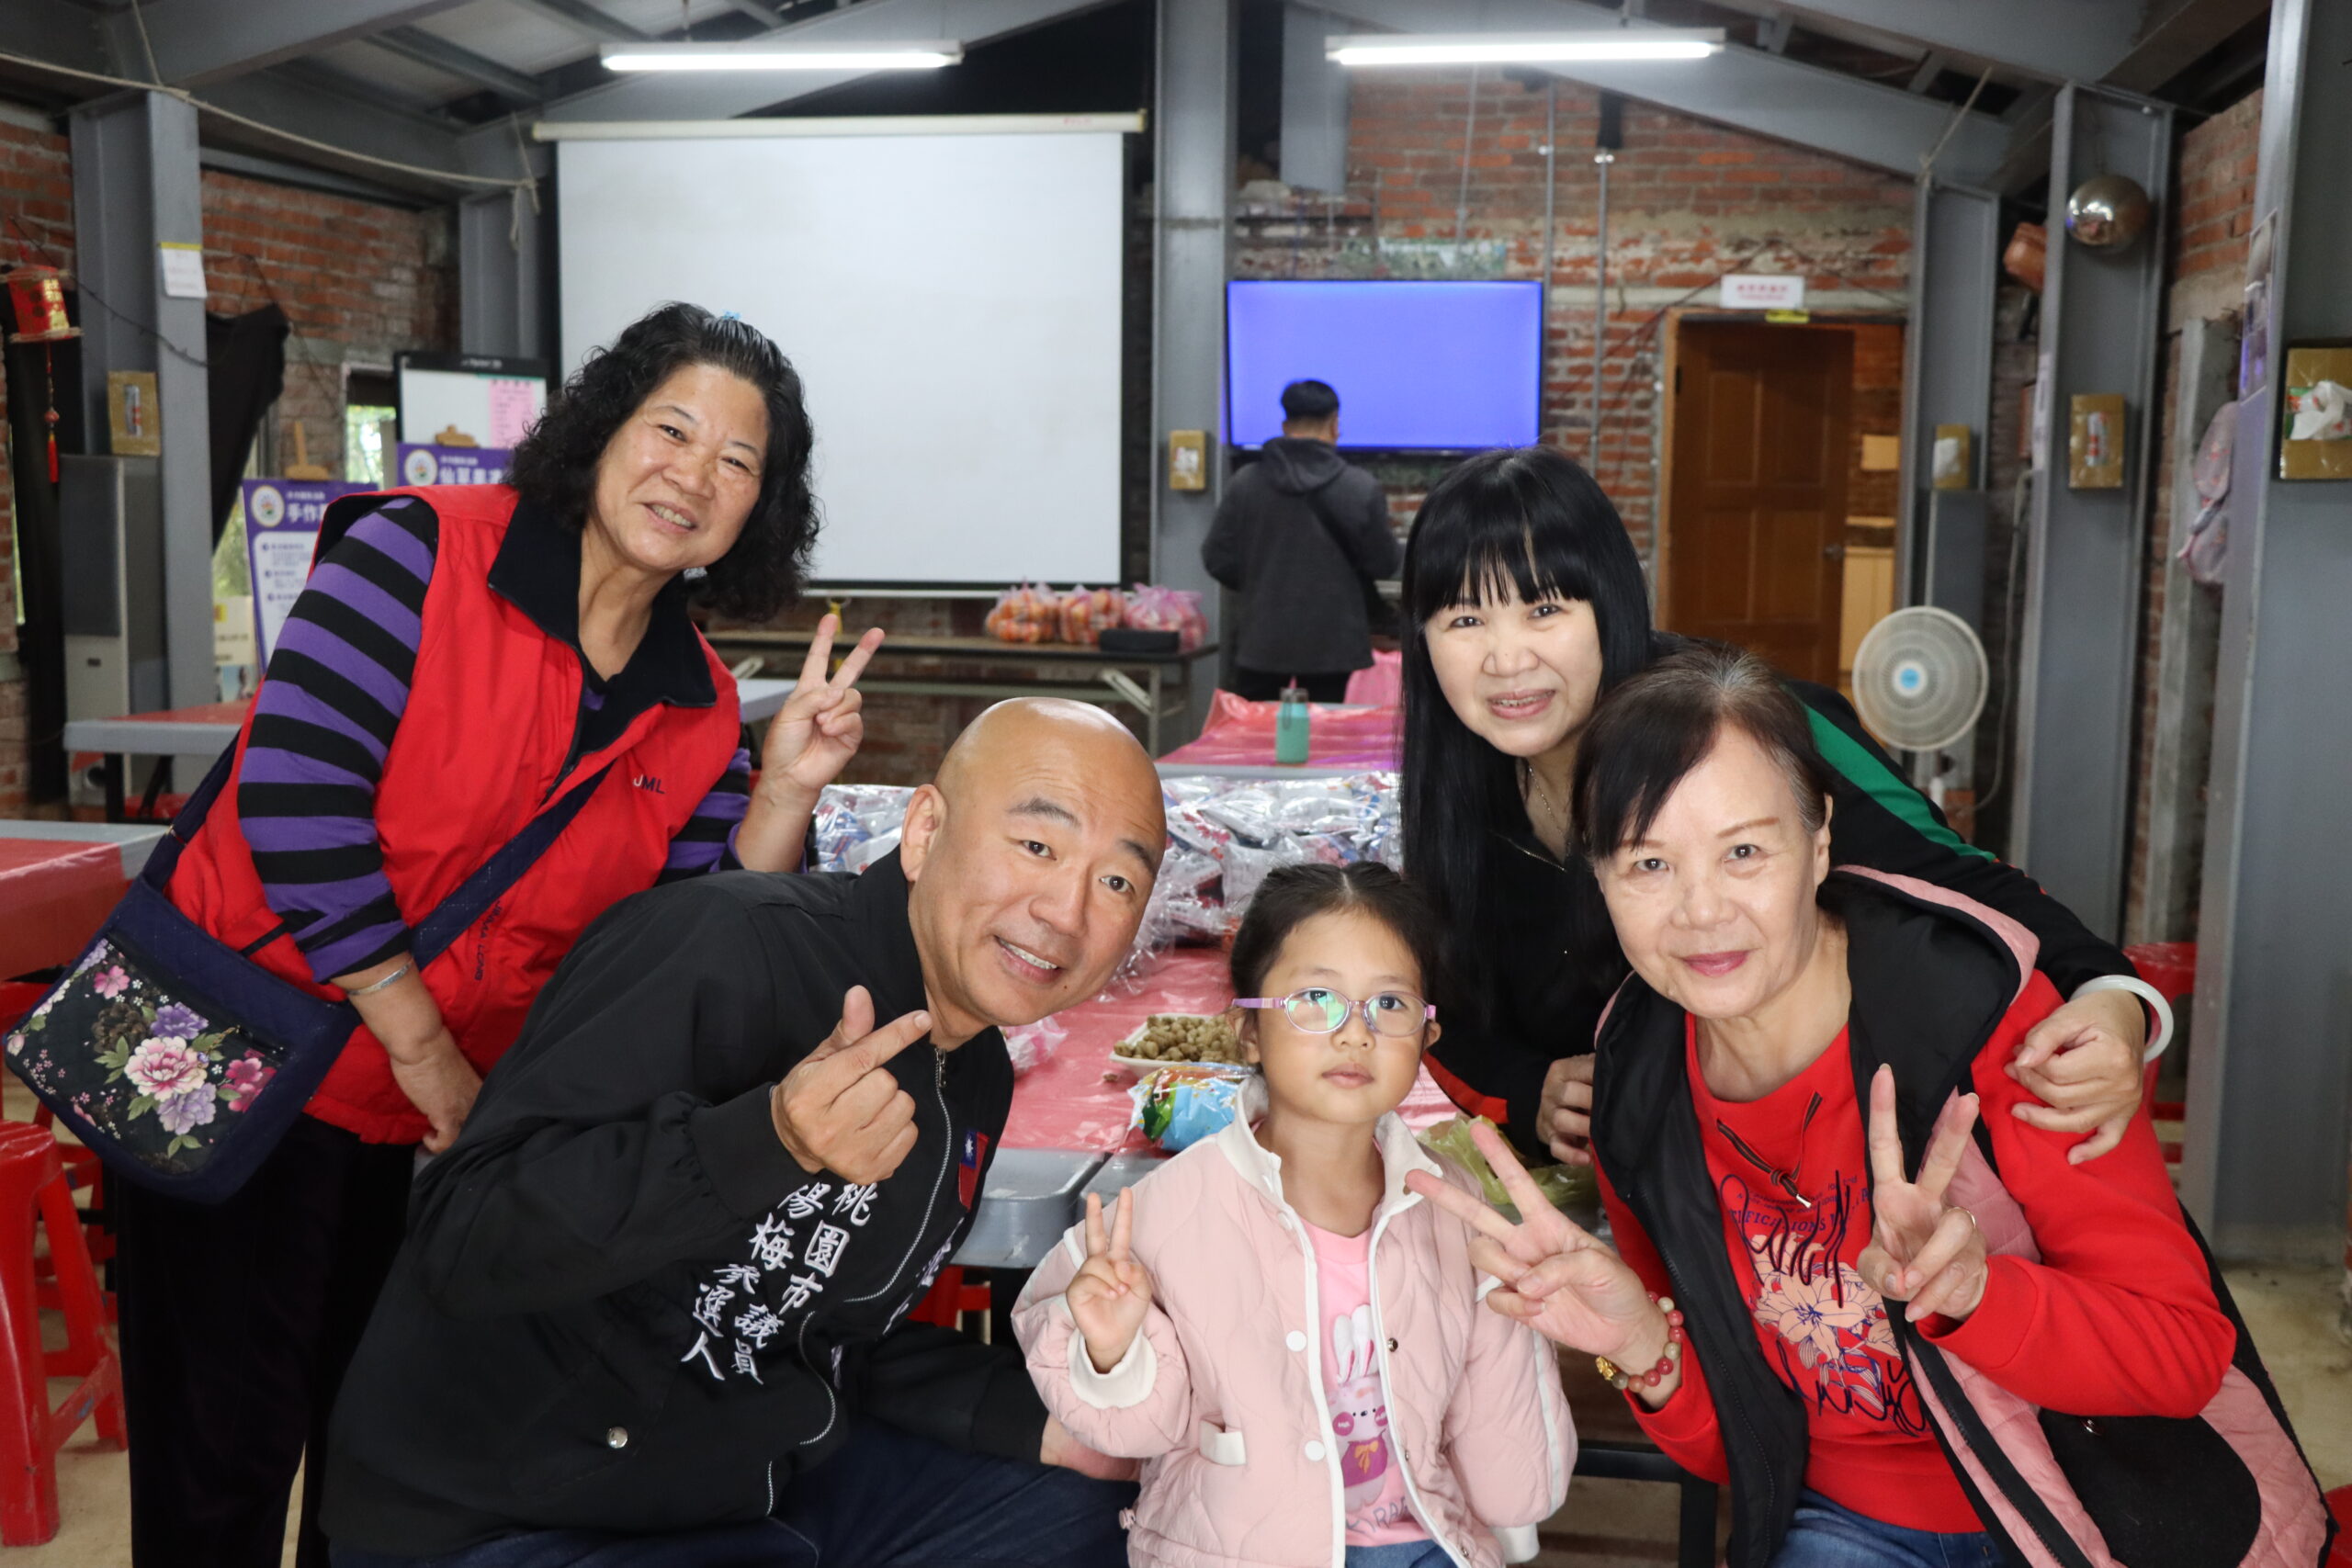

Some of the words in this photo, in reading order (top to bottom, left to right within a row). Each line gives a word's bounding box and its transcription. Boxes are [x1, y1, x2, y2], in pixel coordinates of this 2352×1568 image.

[730, 1182, 878, 1385] 桃園市議員
